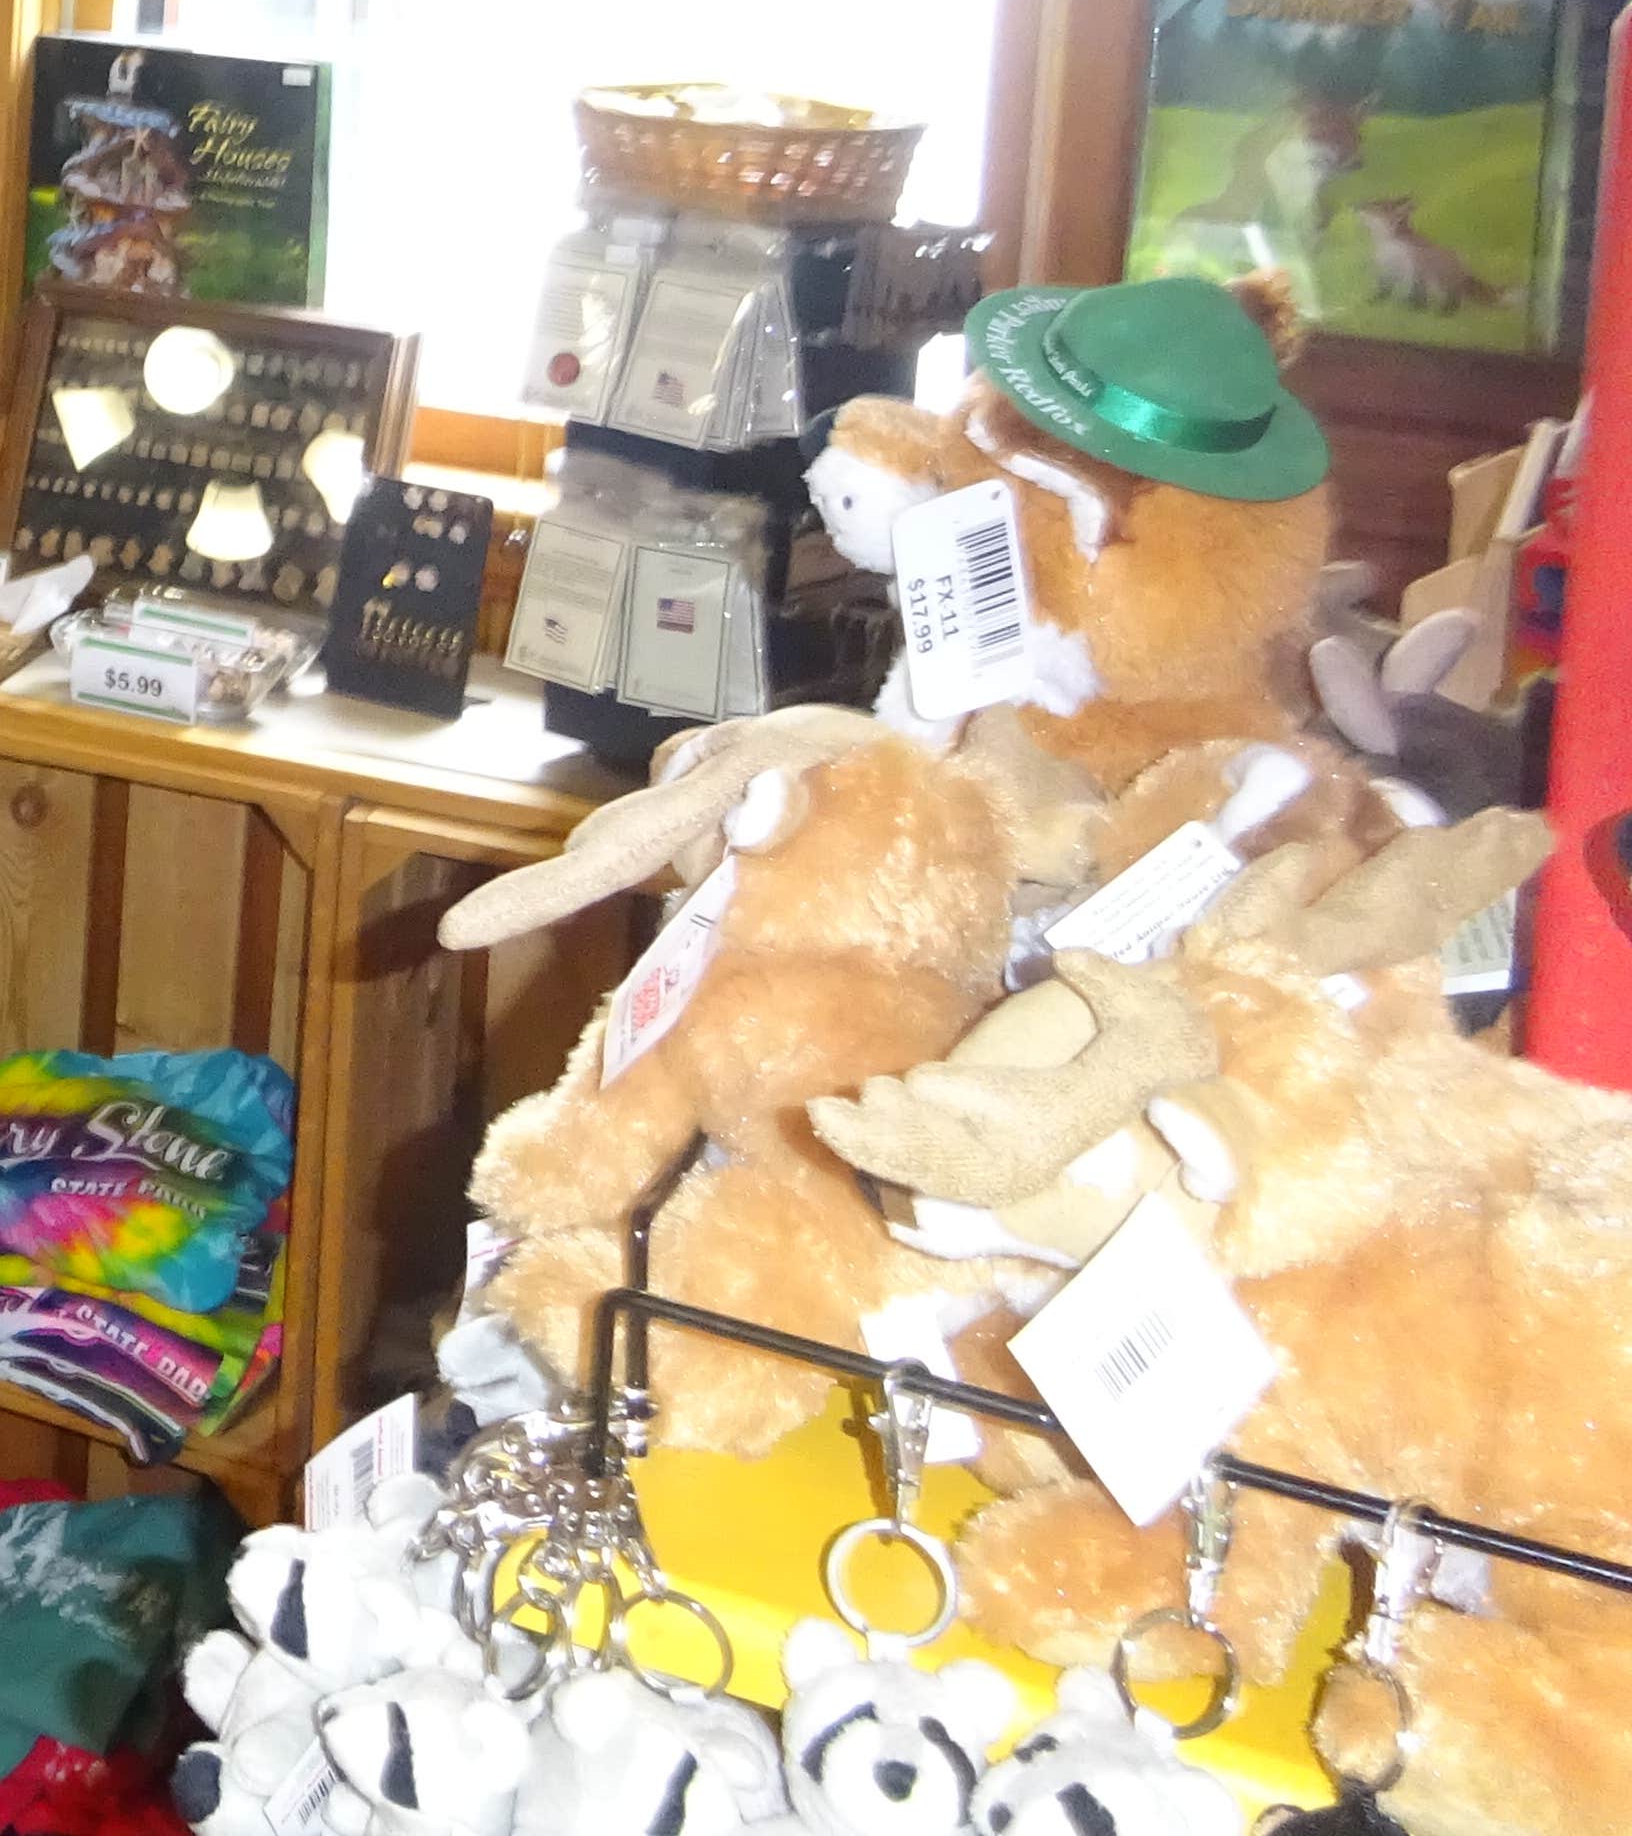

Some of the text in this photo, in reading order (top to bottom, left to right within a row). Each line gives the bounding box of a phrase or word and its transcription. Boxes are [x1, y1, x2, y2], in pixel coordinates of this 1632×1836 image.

[188, 101, 258, 144] Fairy
[189, 137, 292, 172] Houses
[908, 577, 934, 656] $17.99
[104, 667, 162, 697] $5.99
